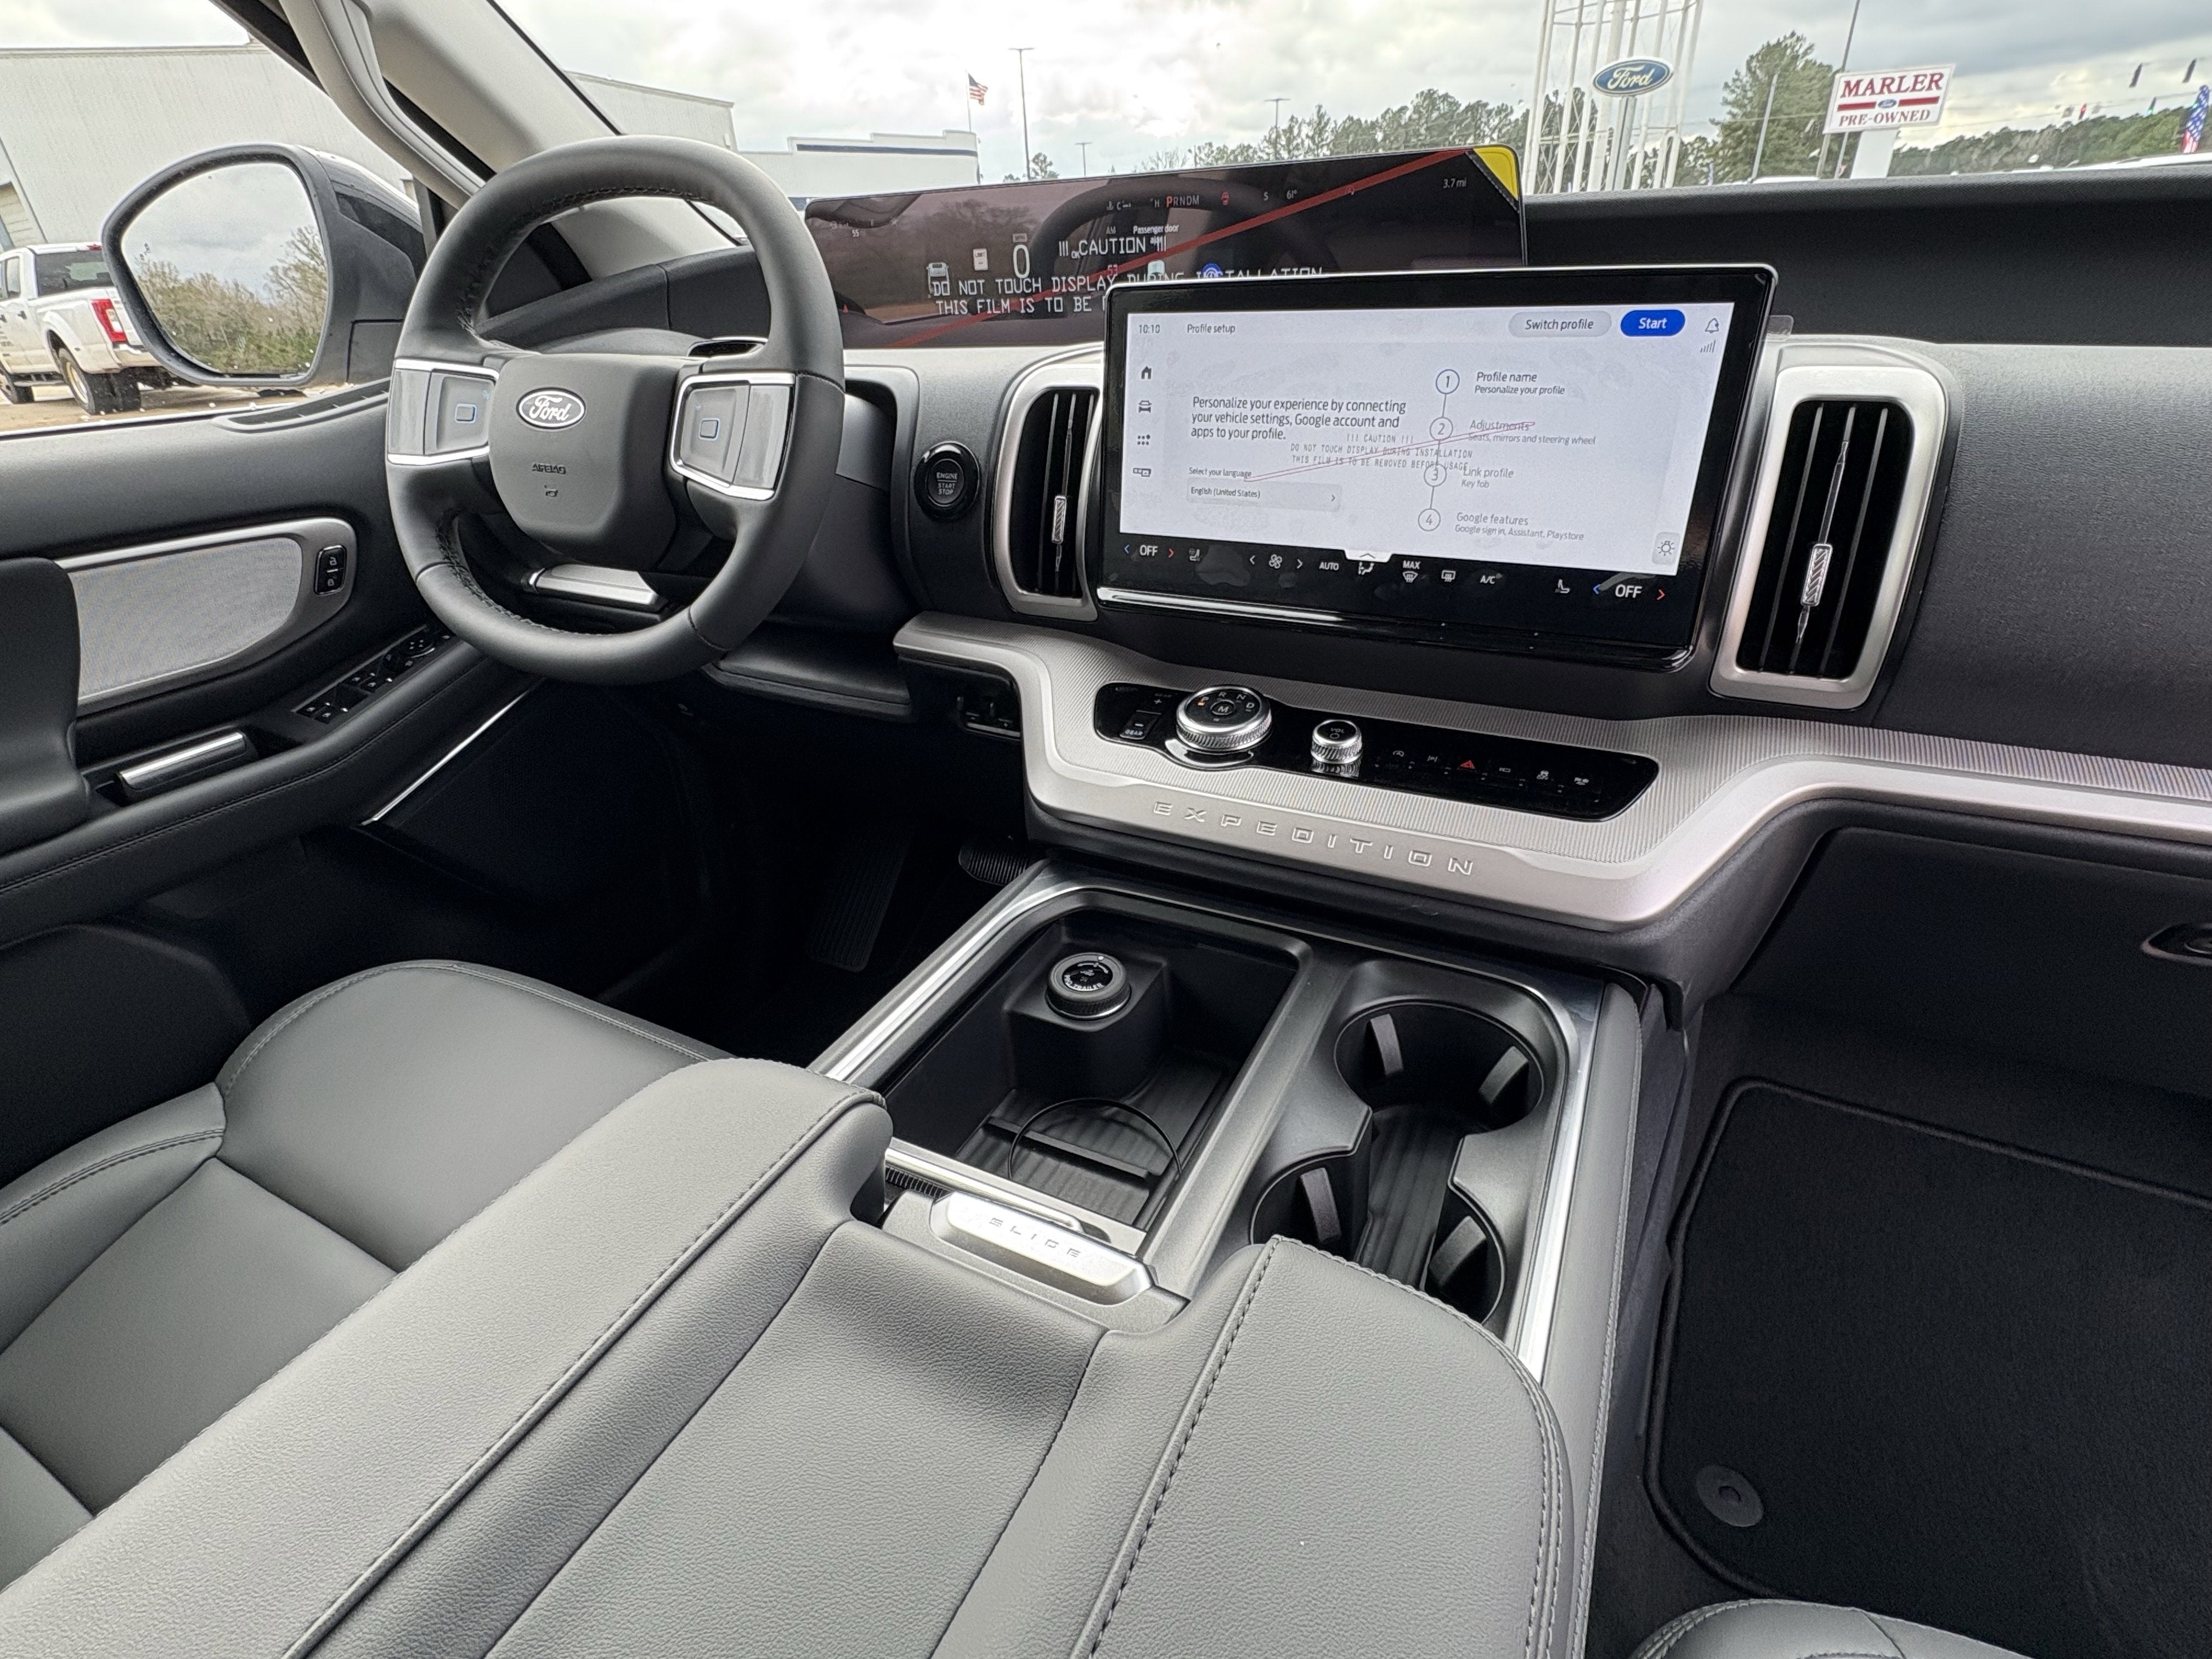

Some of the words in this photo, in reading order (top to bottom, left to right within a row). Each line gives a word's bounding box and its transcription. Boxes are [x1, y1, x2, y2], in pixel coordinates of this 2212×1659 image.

[1607, 65, 1655, 89] Ford
[1839, 72, 1944, 98] MARLER
[1838, 109, 1931, 127] PRE-OWNED
[1443, 178, 1456, 188] 3.7
[1457, 177, 1466, 187] mi
[1133, 225, 1164, 234] Passenger
[1165, 224, 1179, 233] door
[1079, 236, 1146, 256] CAUTION
[933, 280, 950, 296] DO
[959, 280, 985, 295] NOT
[995, 278, 1042, 294] TOUCH
[1052, 274, 1118, 293] DISPLAY
[935, 300, 968, 315] THIS
[977, 300, 1011, 314] FILM
[1020, 298, 1035, 314] IS
[1045, 297, 1063, 312] TO
[1074, 296, 1092, 312] BE
[1139, 324, 1160, 334] 10:10
[1187, 323, 1212, 333] Profile
[1214, 324, 1235, 334] setup
[1525, 318, 1559, 330] Switch
[1560, 318, 1594, 331] profile
[1638, 317, 1668, 329] Start
[1446, 376, 1451, 388] 1
[1476, 371, 1508, 382] Profile
[1509, 374, 1537, 382] name
[1475, 385, 1519, 394] Personalize
[1520, 387, 1538, 396] your
[1539, 385, 1565, 396] profile
[529, 395, 572, 421] Ford
[1193, 396, 1248, 409] Personalize
[1250, 400, 1272, 412] your
[1274, 398, 1329, 413] experience
[1331, 398, 1344, 413] by
[1346, 399, 1406, 414] connecting
[1192, 414, 1214, 426] your
[1215, 411, 1249, 425] vehicle
[1250, 413, 1293, 427] settings,
[1295, 413, 1331, 428] Google
[1333, 416, 1376, 428] account
[1378, 416, 1400, 428] and
[1470, 419, 1530, 432] Adjustments
[1191, 428, 1214, 439] apps
[1216, 427, 1227, 438] to
[1228, 430, 1250, 440] your
[1251, 427, 1286, 441] profile.
[1437, 423, 1446, 435] 2
[1363, 434, 1396, 443] CAUTION
[1493, 435, 1521, 443] mirrors
[1522, 434, 1536, 443] and
[1538, 435, 1570, 445] steering
[1571, 436, 1596, 445] wheel
[1291, 443, 1300, 452] DO
[1304, 444, 1317, 452] NOT
[1321, 445, 1342, 454] TOUCH
[1346, 445, 1378, 454] DISPLAY
[1415, 448, 1472, 459] INSTALLATION
[1292, 455, 1310, 464] THIS
[1313, 456, 1330, 465] FILM
[1335, 457, 1344, 465] IS
[1348, 457, 1357, 466] TO
[1361, 458, 1370, 466] BE
[1375, 459, 1407, 467] REMOVED
[1444, 462, 1468, 471] USAGE
[1189, 467, 1207, 476] Select
[1223, 468, 1252, 479] language
[1431, 467, 1439, 481] 3
[1463, 467, 1481, 477] Link
[1483, 467, 1514, 478] profile
[1462, 479, 1475, 488] Key
[1476, 479, 1489, 488] fob
[1190, 487, 1212, 496] English
[1214, 488, 1236, 497] (United
[1237, 488, 1261, 499] States)
[1425, 514, 1433, 526] 4
[1457, 512, 1488, 524] Google
[1490, 513, 1529, 525] features
[1454, 524, 1481, 534] Google
[1482, 526, 1497, 536] sign
[1508, 528, 1544, 538] Assistant,
[1547, 530, 1584, 540] Playstore
[1139, 544, 1158, 557] OFF
[1319, 561, 1340, 572] AUTO
[1403, 561, 1420, 570] MAX
[1480, 575, 1496, 585] A/C
[1615, 584, 1642, 599] OFF
[1153, 801, 1473, 876] EXPEDITION
[1074, 983, 1105, 991] TRAILER
